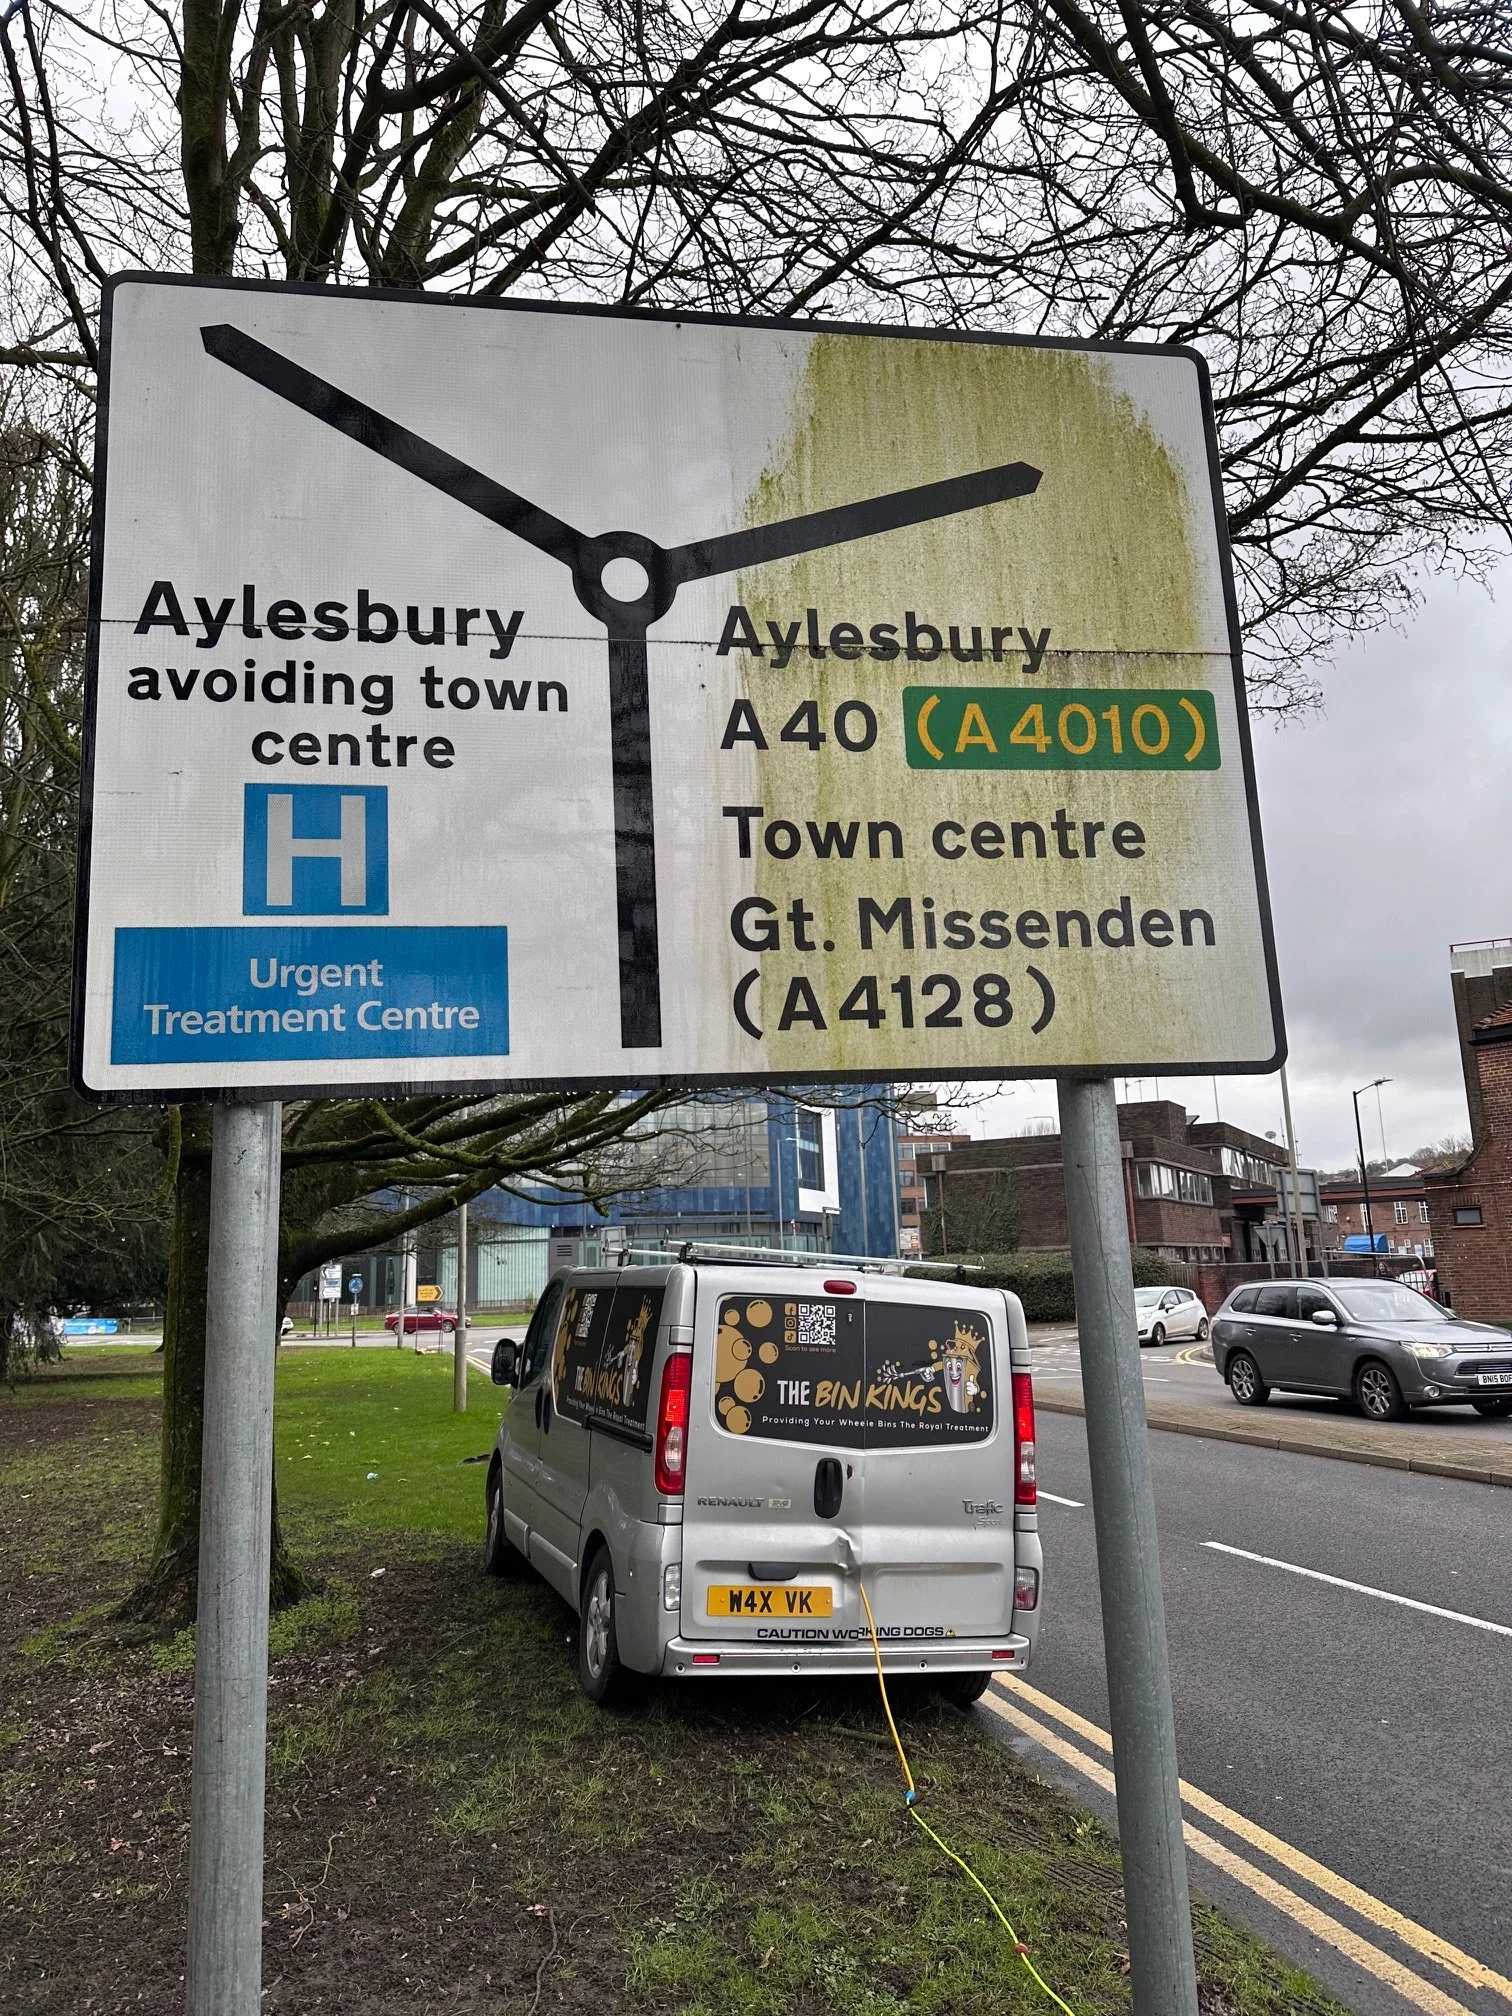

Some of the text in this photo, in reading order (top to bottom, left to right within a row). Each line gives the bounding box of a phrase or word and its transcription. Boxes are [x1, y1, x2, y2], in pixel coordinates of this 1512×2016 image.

[134, 580, 525, 659] Aylesbury
[716, 605, 1052, 674] Aylesbury
[127, 657, 569, 716] avoiding town
[251, 723, 456, 769] centre
[720, 694, 1206, 763] A40 (A4010)
[266, 794, 367, 907] H
[722, 806, 1147, 860] Town centre
[730, 895, 1217, 953] Gt. Missenden
[249, 957, 384, 996] Urgent
[143, 1001, 480, 1036] Treatment Centre
[733, 964, 1056, 1041] (A4128)
[784, 1344, 801, 1352] Scan
[777, 1379, 943, 1417] THE BIN KINGS
[762, 1415, 811, 1428] Providing
[813, 1417, 836, 1427] Your
[877, 1419, 897, 1429] Bins
[900, 1420, 916, 1430] The
[919, 1421, 944, 1432] Royal
[944, 1422, 990, 1434] Treatment
[697, 1495, 765, 1508] RENAULT
[962, 1499, 1005, 1515] Trafic
[729, 1589, 813, 1613] W4X VK
[757, 1628, 830, 1640] CAUTION
[903, 1626, 945, 1637] DOGS
